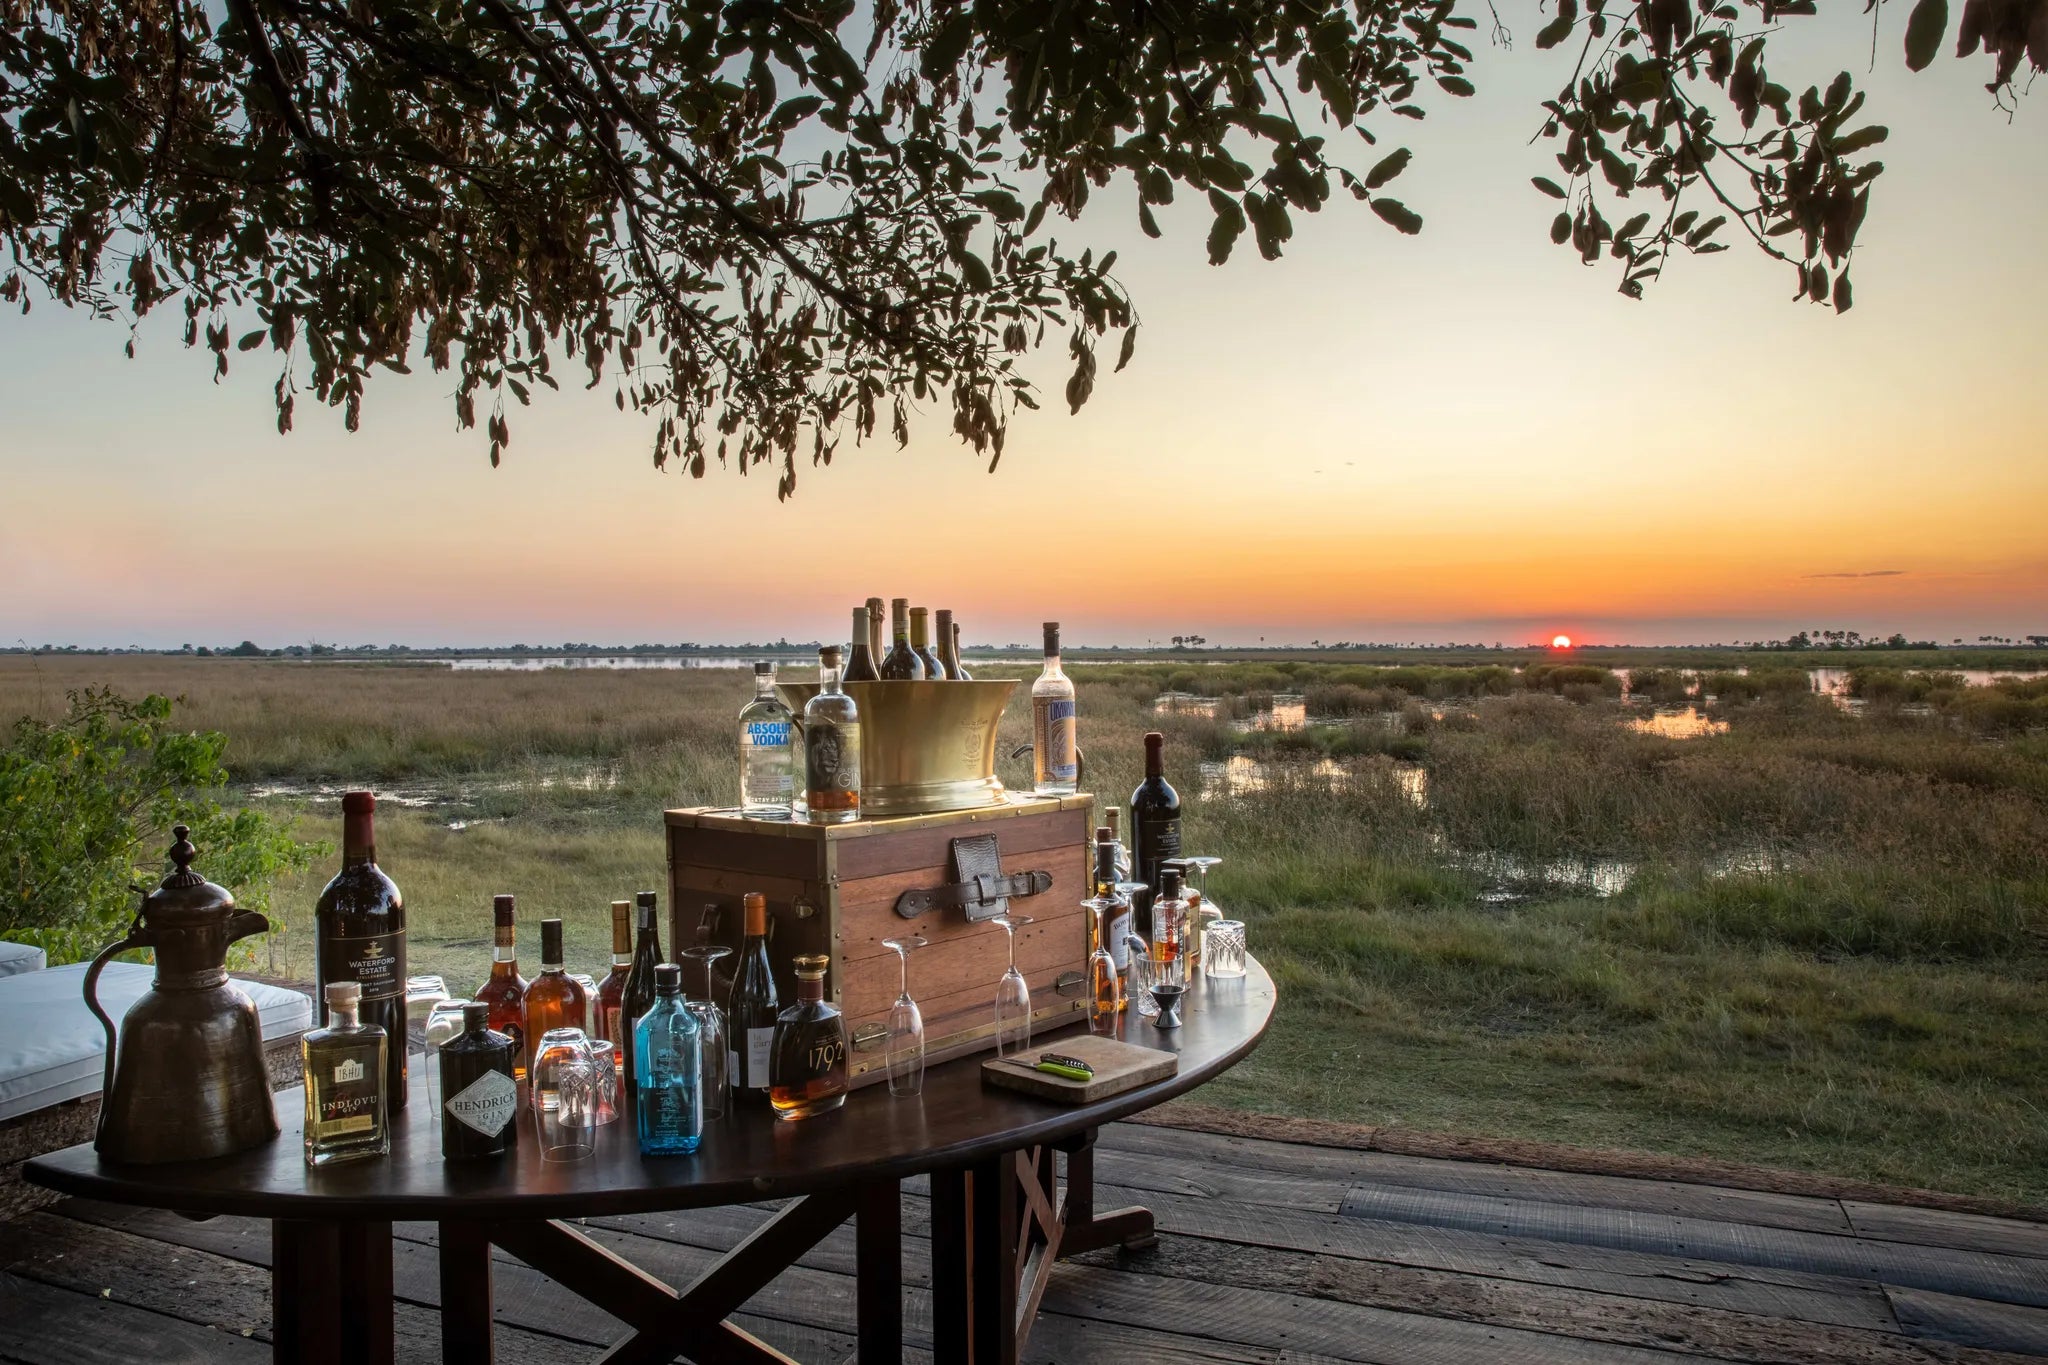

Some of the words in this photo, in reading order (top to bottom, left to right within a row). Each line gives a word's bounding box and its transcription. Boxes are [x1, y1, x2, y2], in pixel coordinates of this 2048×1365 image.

[747, 723, 792, 735] ABSOLUT
[752, 734, 789, 746] VODKA
[349, 956, 396, 968] WATERFORD
[359, 965, 388, 975] ESTATE
[809, 1041, 843, 1071] 1792
[339, 1067, 360, 1081] IBHU
[322, 1096, 378, 1112] INDLOVU
[482, 1109, 504, 1120] GIN
